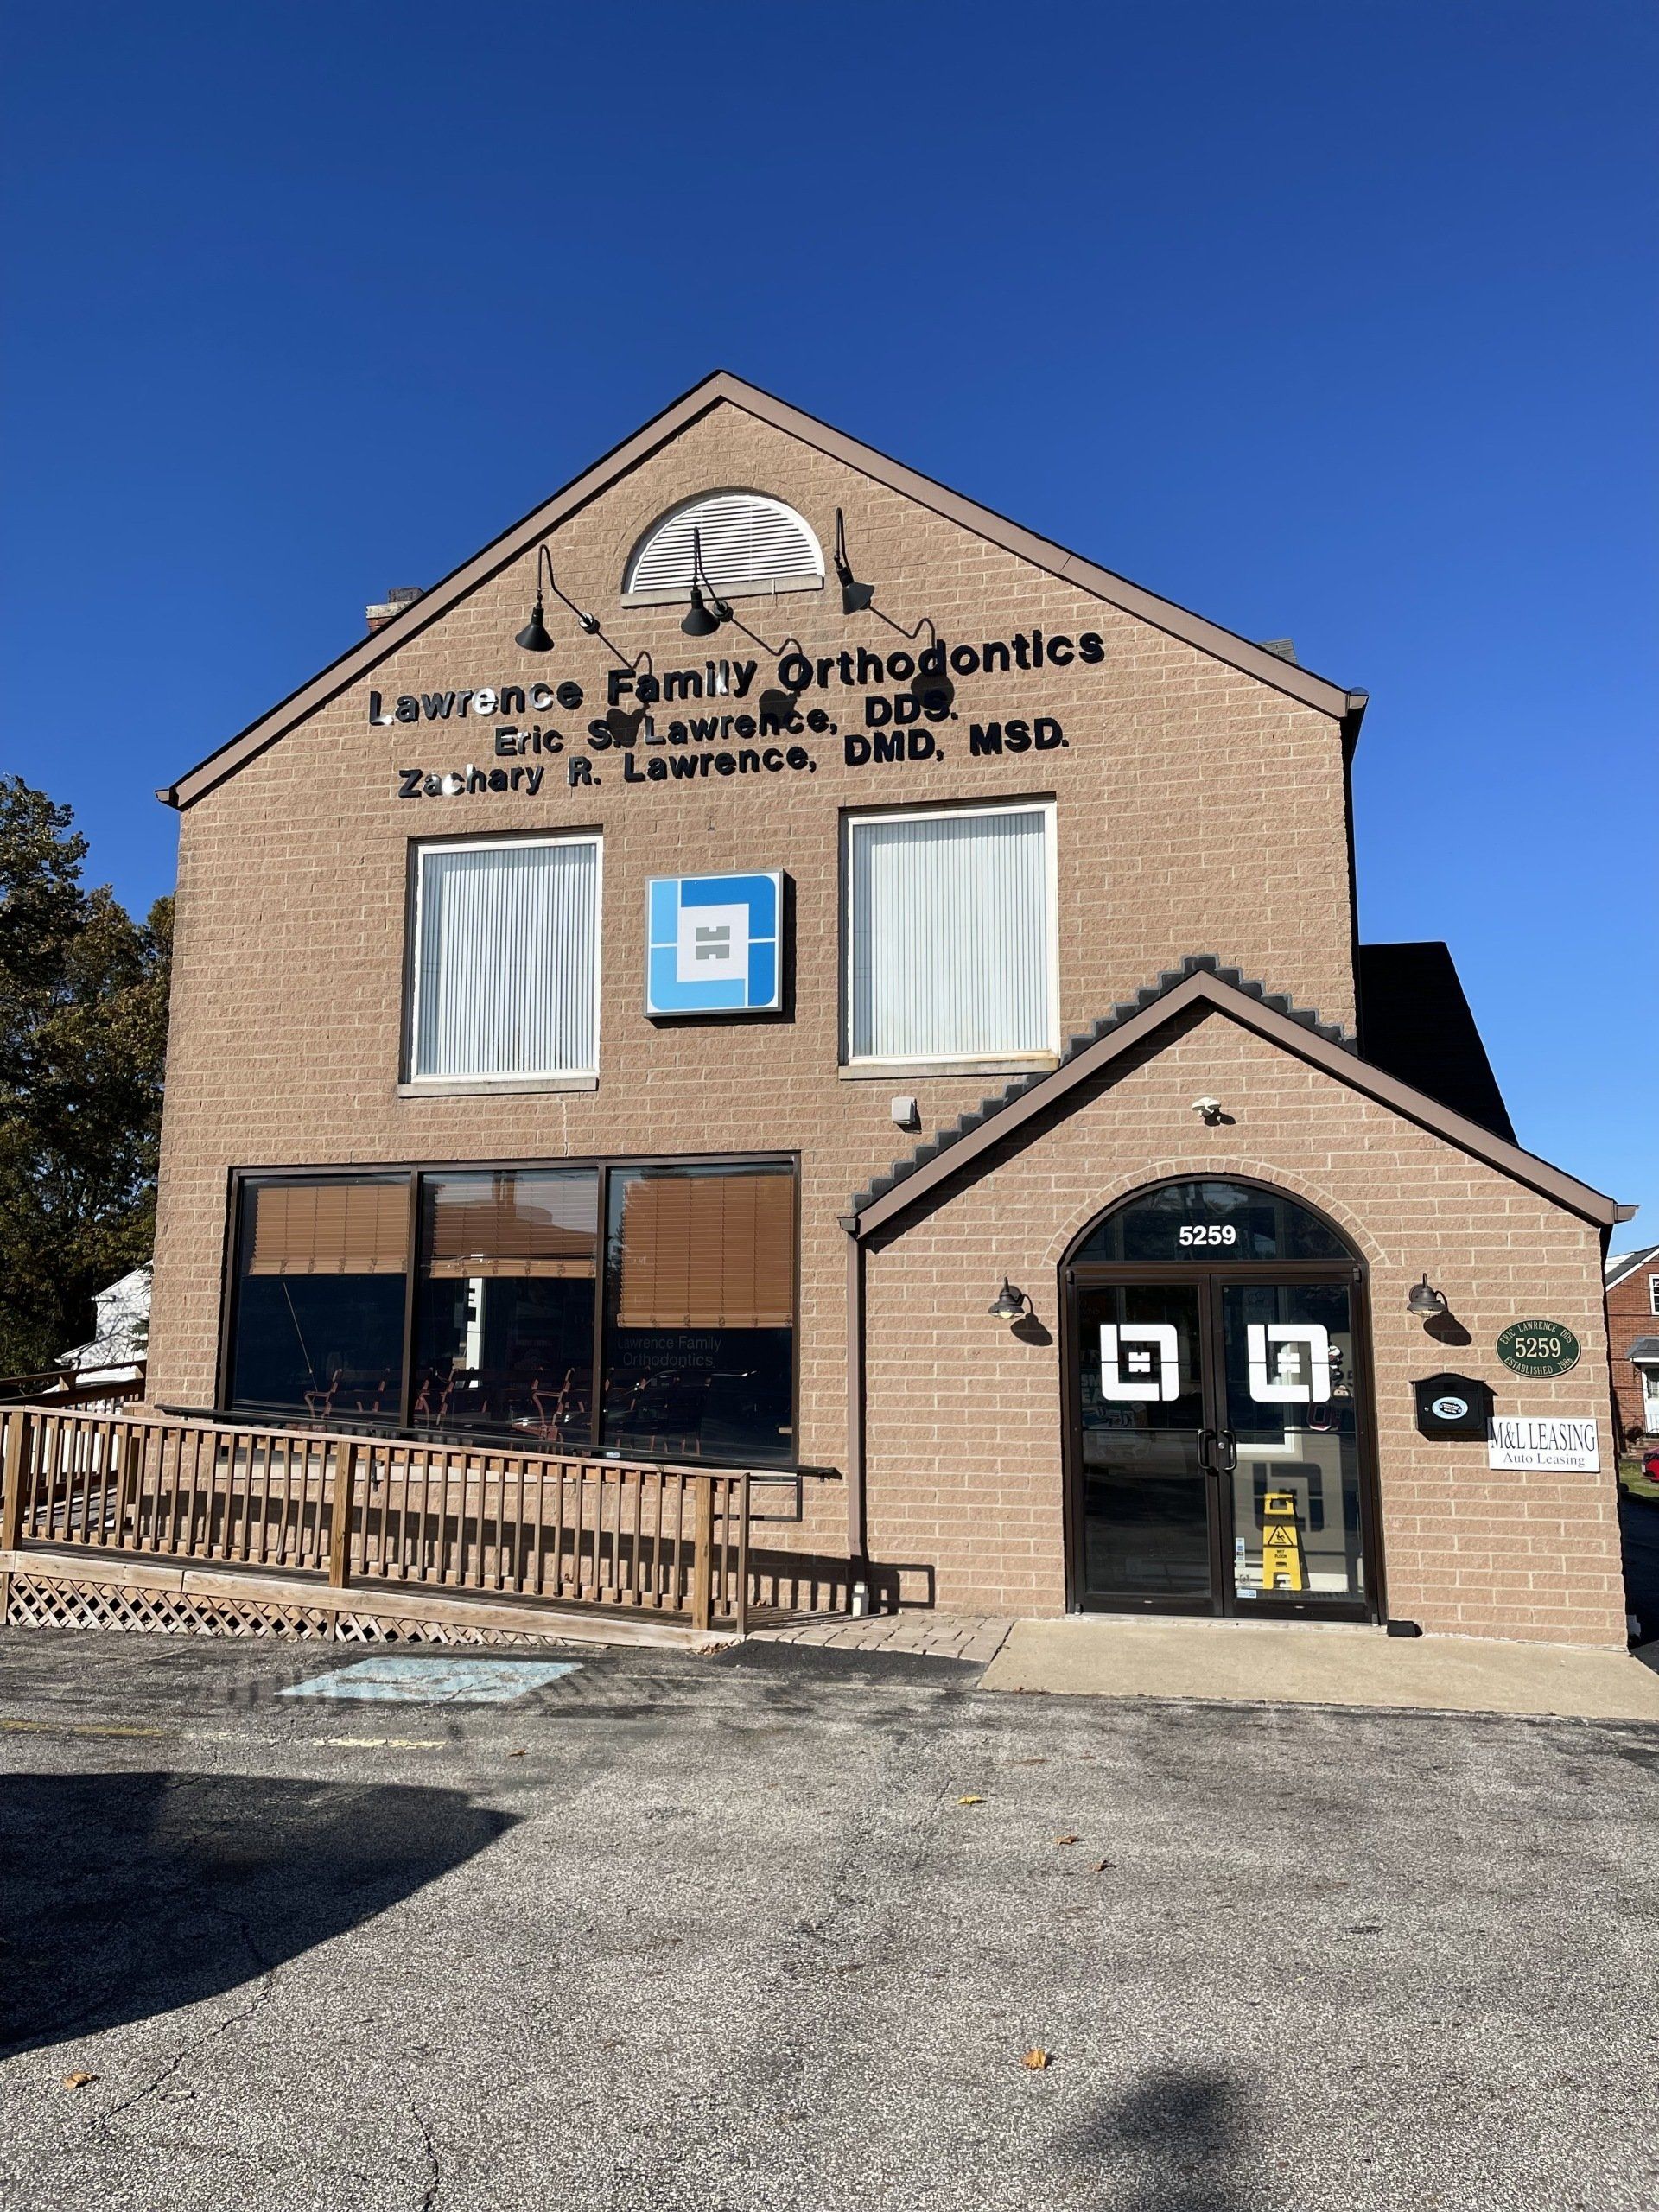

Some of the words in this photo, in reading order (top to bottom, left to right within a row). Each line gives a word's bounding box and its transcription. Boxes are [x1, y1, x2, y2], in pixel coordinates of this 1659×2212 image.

[370, 681, 584, 726] Lawrence
[607, 659, 758, 707] Family
[778, 629, 1105, 691] Orthodontics
[494, 724, 563, 757] Eric
[587, 719, 621, 751] S.
[645, 708, 838, 747] Lawrence,
[865, 691, 958, 728] DDS.
[397, 763, 544, 798] Zachary
[567, 756, 601, 786] R.
[623, 745, 817, 783] Lawrence,
[844, 728, 944, 767] DMD,
[969, 716, 1070, 757] MSD.
[1179, 1224, 1236, 1246] 5259
[1499, 1328, 1516, 1345] ERIC
[1516, 1320, 1558, 1333] LAWRENCE
[1559, 1329, 1574, 1344] DDS
[677, 1336, 722, 1353] Family
[1515, 1337, 1561, 1358] 5259
[623, 1351, 714, 1367] Orthodontics
[1503, 1355, 1553, 1375] ESTABLISHED
[1490, 1422, 1526, 1449] M&L
[1529, 1423, 1595, 1452] LEASING
[1503, 1452, 1533, 1464] Auto
[1537, 1453, 1586, 1468] Leasing
